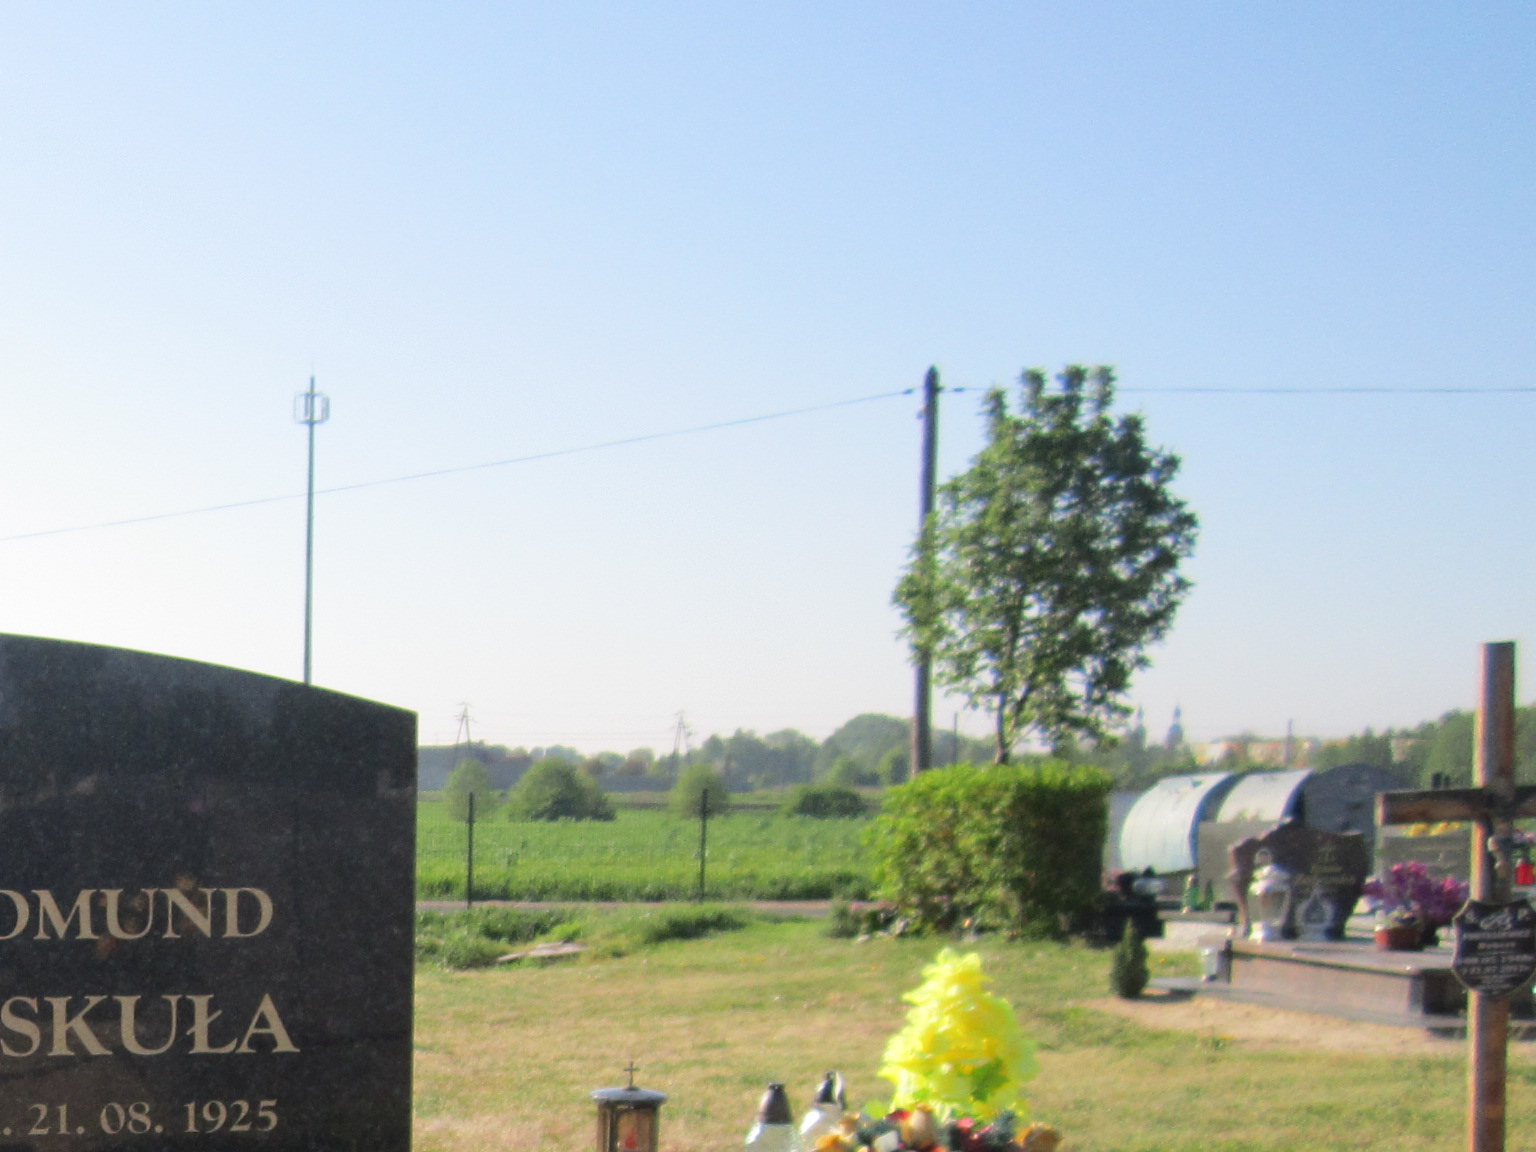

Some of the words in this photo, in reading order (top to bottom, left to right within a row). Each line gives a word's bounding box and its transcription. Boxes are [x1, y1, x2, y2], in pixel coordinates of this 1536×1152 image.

[27, 1102, 85, 1136] 21.
[100, 1101, 163, 1134] 08.
[183, 1098, 279, 1133] 1925
